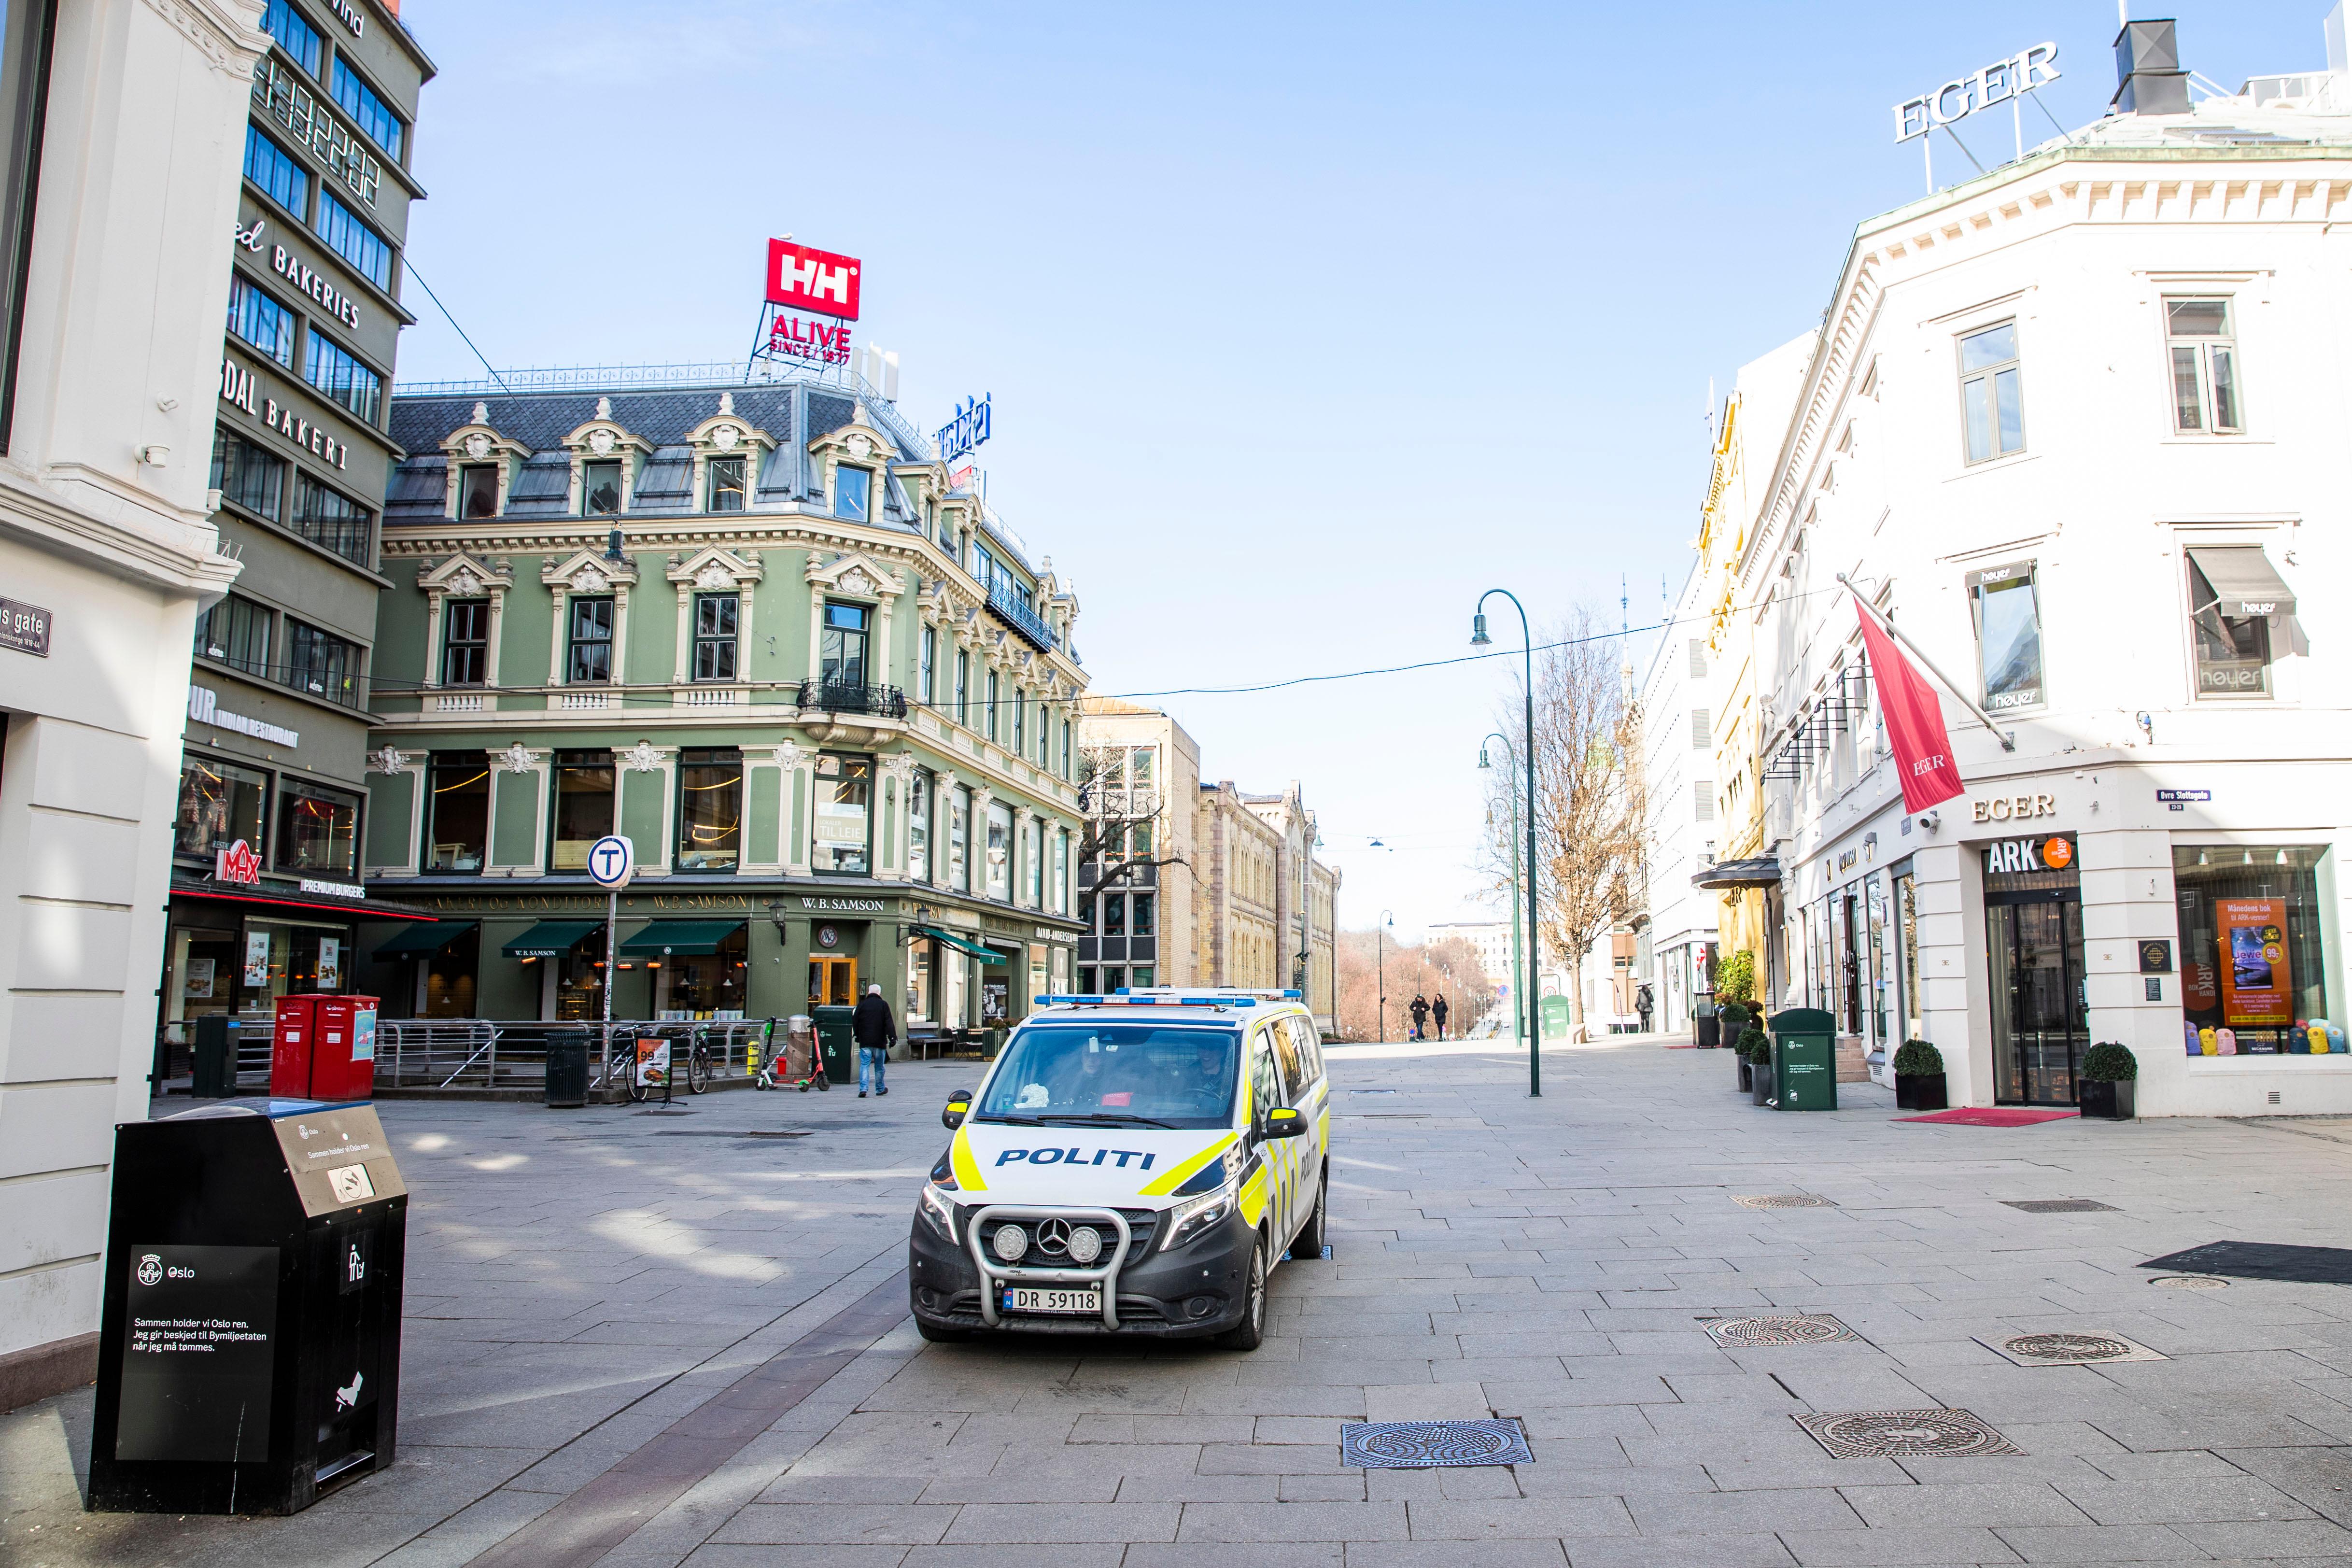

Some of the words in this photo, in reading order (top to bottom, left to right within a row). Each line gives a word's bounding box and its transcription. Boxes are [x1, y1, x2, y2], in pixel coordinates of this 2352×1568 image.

[1892, 41, 2062, 144] EGER
[274, 245, 359, 329] BAKERIES
[780, 254, 848, 304] HH
[771, 314, 851, 352] ALIVE
[769, 339, 810, 358] SINCE
[822, 349, 851, 366] 1877
[219, 356, 256, 416] DAL
[266, 398, 347, 470] BAKERI
[14, 613, 43, 635] gate
[2199, 668, 2260, 689] høyer
[1995, 691, 2036, 708] høyer
[187, 685, 216, 725] UR
[215, 709, 248, 735] INDIAN
[248, 719, 299, 749] RESTAURANT
[1914, 754, 1945, 777] EGER
[2160, 791, 2175, 800] Øvre
[2176, 791, 2209, 801] Slottsgate
[1970, 793, 2055, 823] EGER
[819, 826, 836, 837] TIL
[839, 826, 861, 838] LEIE
[1988, 839, 2039, 874] ARK
[2056, 837, 2068, 855] ARK
[222, 840, 262, 885] MAX
[599, 849, 620, 876] T
[305, 879, 337, 895] PREMIUM
[337, 883, 366, 899] BURGERS
[489, 896, 508, 910] OG
[516, 896, 608, 910] KONDITORI
[687, 895, 747, 909] SAMSON
[801, 897, 816, 909] W.
[818, 898, 830, 909] B.
[831, 899, 885, 912] SAMSON
[2227, 904, 2258, 912] Månedens
[2197, 962, 2214, 990] ARK
[308, 1149, 329, 1159] Sammen
[329, 1147, 344, 1156] holder
[995, 1147, 1156, 1171] POLITI
[1300, 1141, 1317, 1187] POLITI
[168, 1267, 195, 1279] Oslo
[1018, 1291, 1039, 1307] DR
[1048, 1292, 1096, 1309] 59118
[135, 1318, 171, 1327] Sammen
[173, 1319, 200, 1328] holder
[202, 1319, 210, 1328] vi
[211, 1319, 230, 1328] Oslo
[133, 1330, 148, 1341] Jeg
[150, 1330, 162, 1341] gir
[164, 1330, 197, 1342] beskjed
[198, 1331, 208, 1340] til
[209, 1331, 267, 1342] Bymiljøetaten
[133, 1342, 148, 1351] når
[148, 1342, 162, 1353] jeg
[164, 1342, 176, 1351] må
